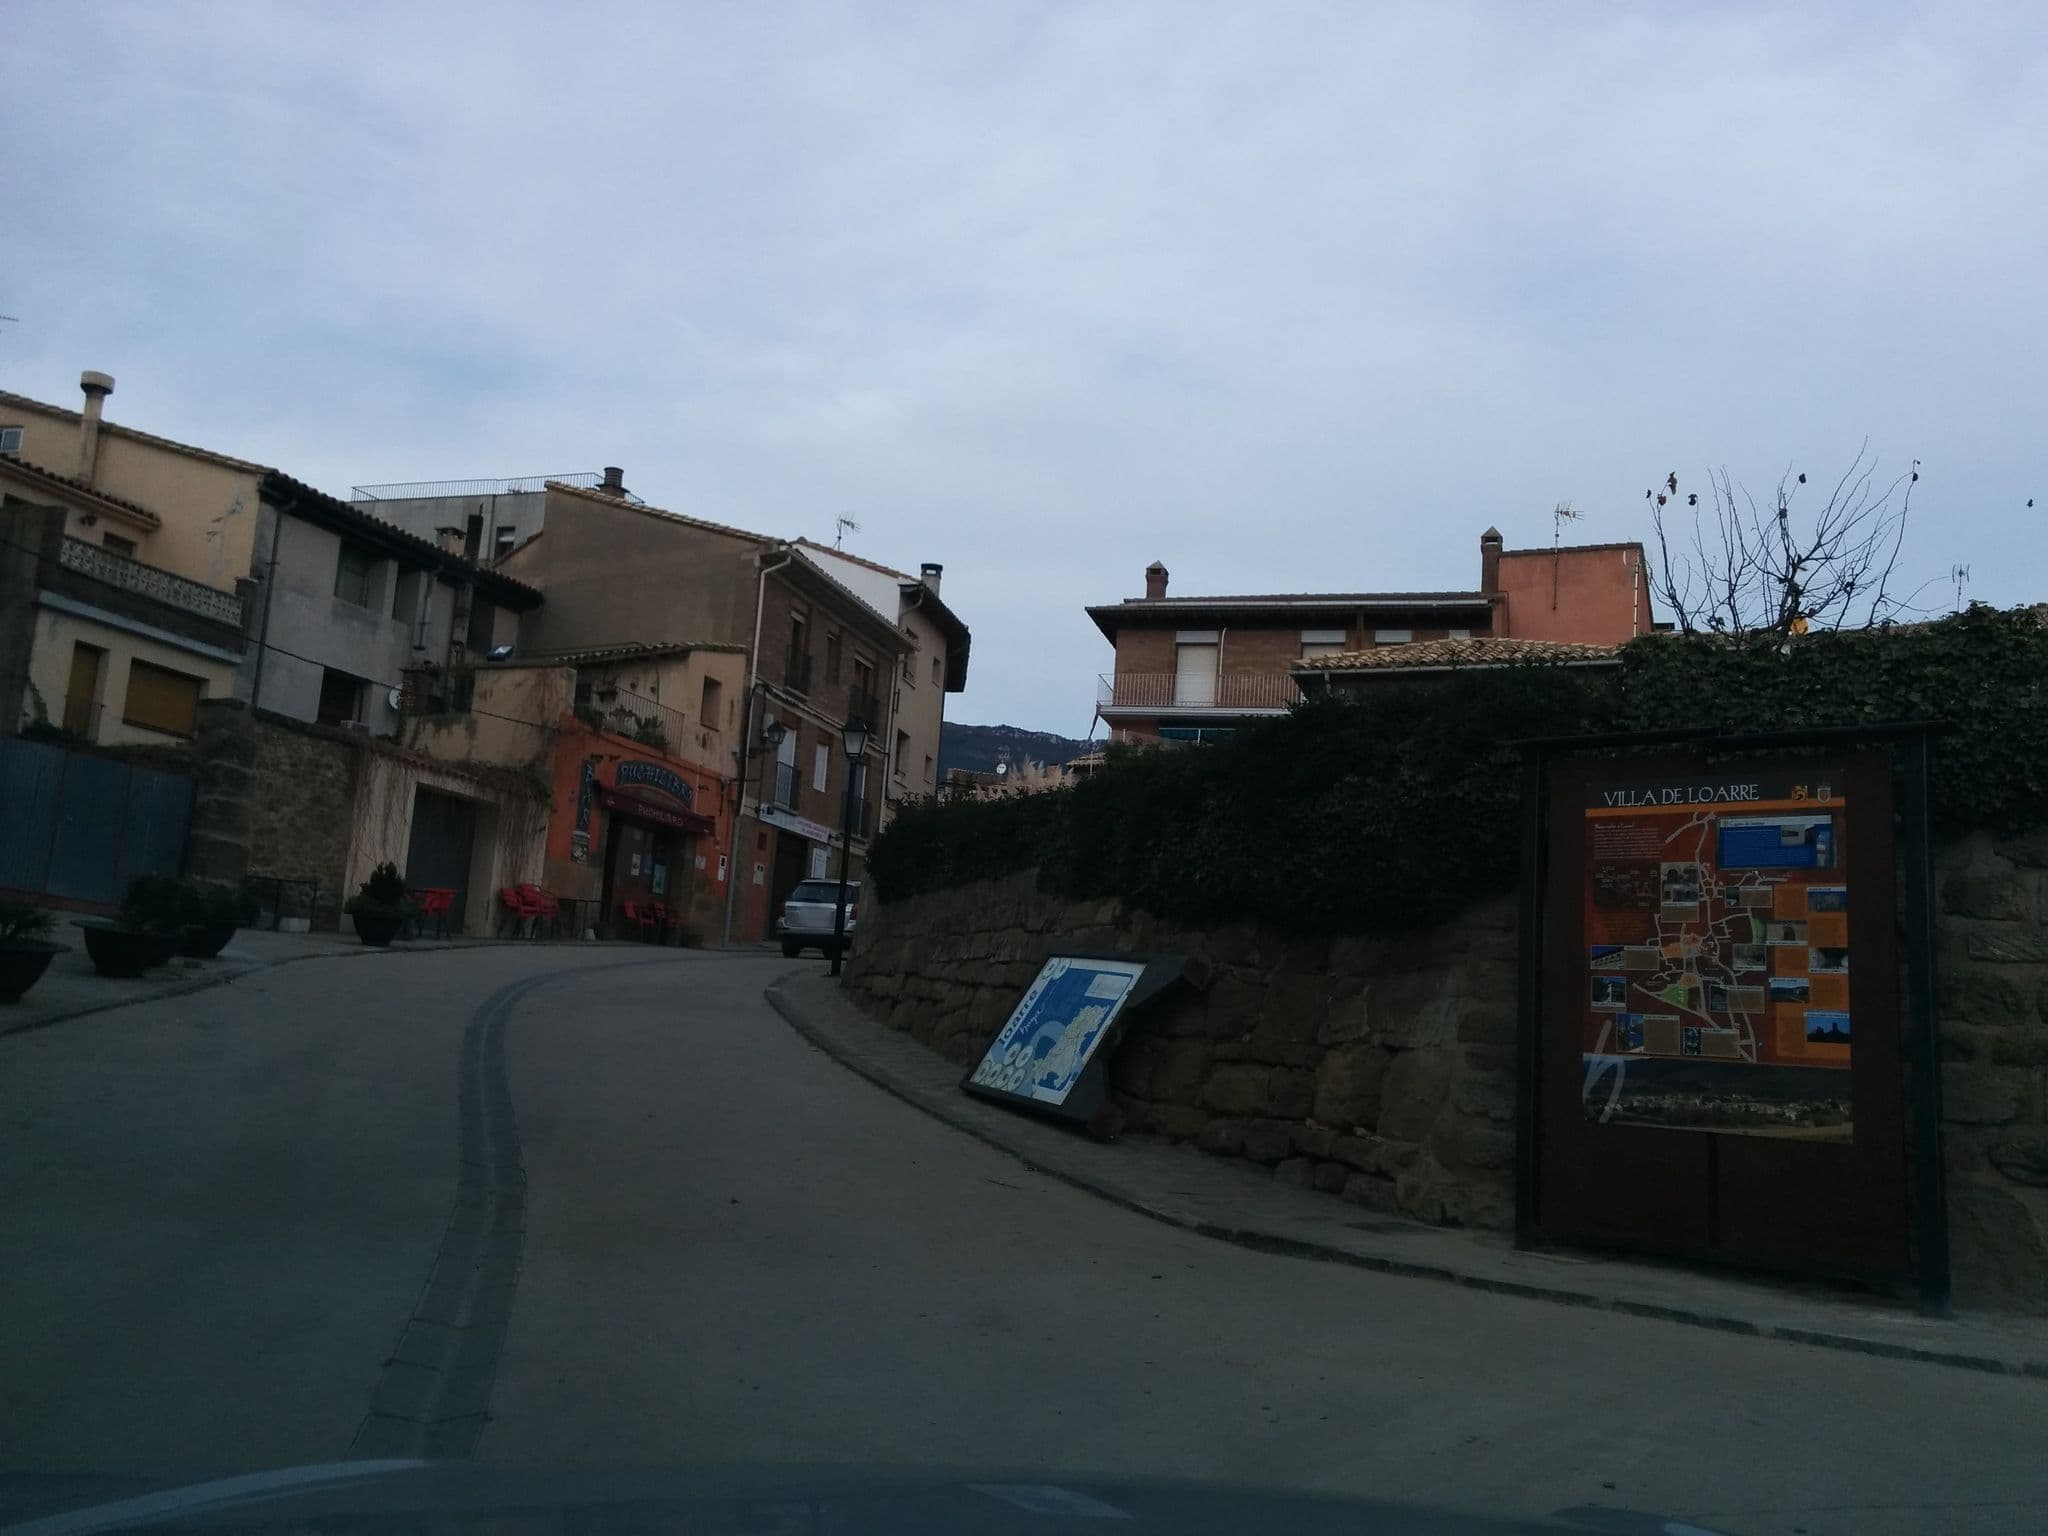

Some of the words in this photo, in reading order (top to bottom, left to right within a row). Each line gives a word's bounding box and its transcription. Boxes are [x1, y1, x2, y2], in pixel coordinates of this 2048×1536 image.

[1604, 789, 1657, 807] VILLA
[1662, 788, 1684, 804] DE
[1688, 784, 1760, 803] LOARRE
